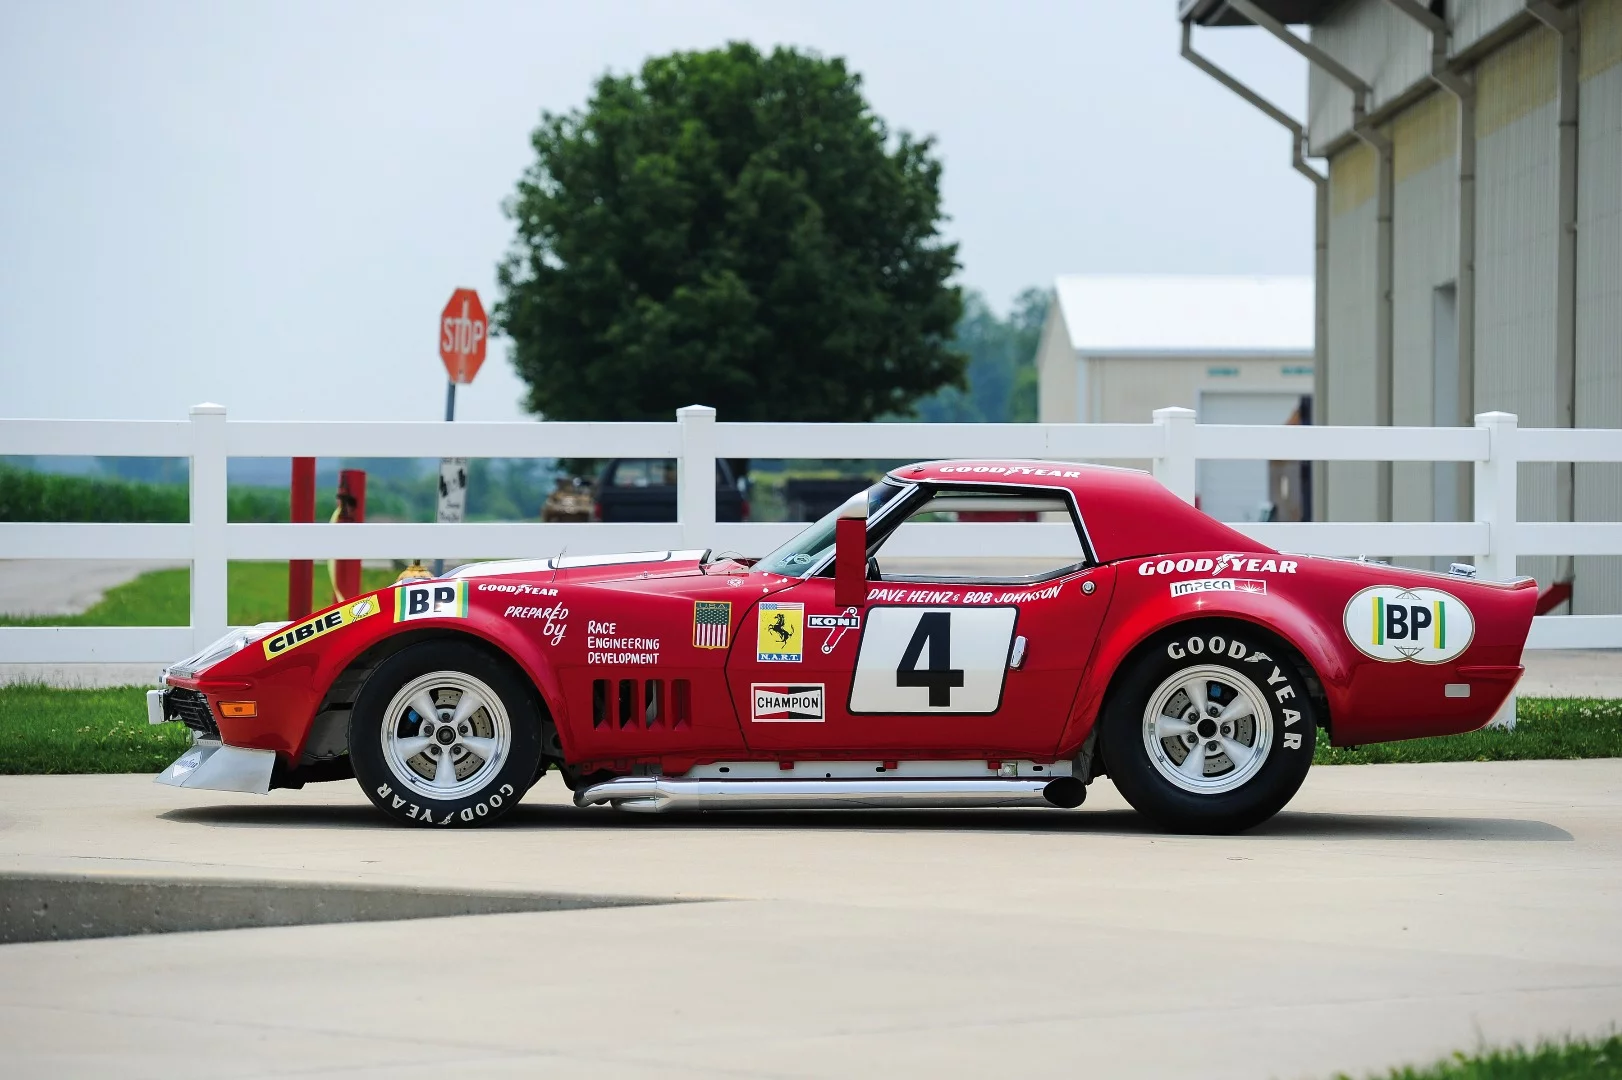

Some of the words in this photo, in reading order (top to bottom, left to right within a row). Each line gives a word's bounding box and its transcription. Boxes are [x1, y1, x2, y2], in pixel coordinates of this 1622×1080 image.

[443, 317, 484, 354] STOP
[867, 588, 907, 600] DAVE
[906, 590, 955, 603] HEINZ
[963, 591, 993, 604] BOB
[994, 585, 1063, 603] JOHNSON
[1174, 580, 1232, 595] IMPECA
[409, 586, 455, 615] BP
[504, 604, 569, 619] PREPARED
[543, 606, 568, 646] by
[588, 620, 616, 634] RACE
[811, 616, 857, 626] KONI
[1386, 604, 1432, 640] BP
[268, 611, 343, 653] CIBIE
[588, 637, 660, 650] ENGINEERING
[588, 652, 660, 664] DEVELOPMENT
[760, 653, 799, 661] N.A.R.T.
[896, 612, 964, 707] 4
[757, 697, 819, 708] CHAMPION
